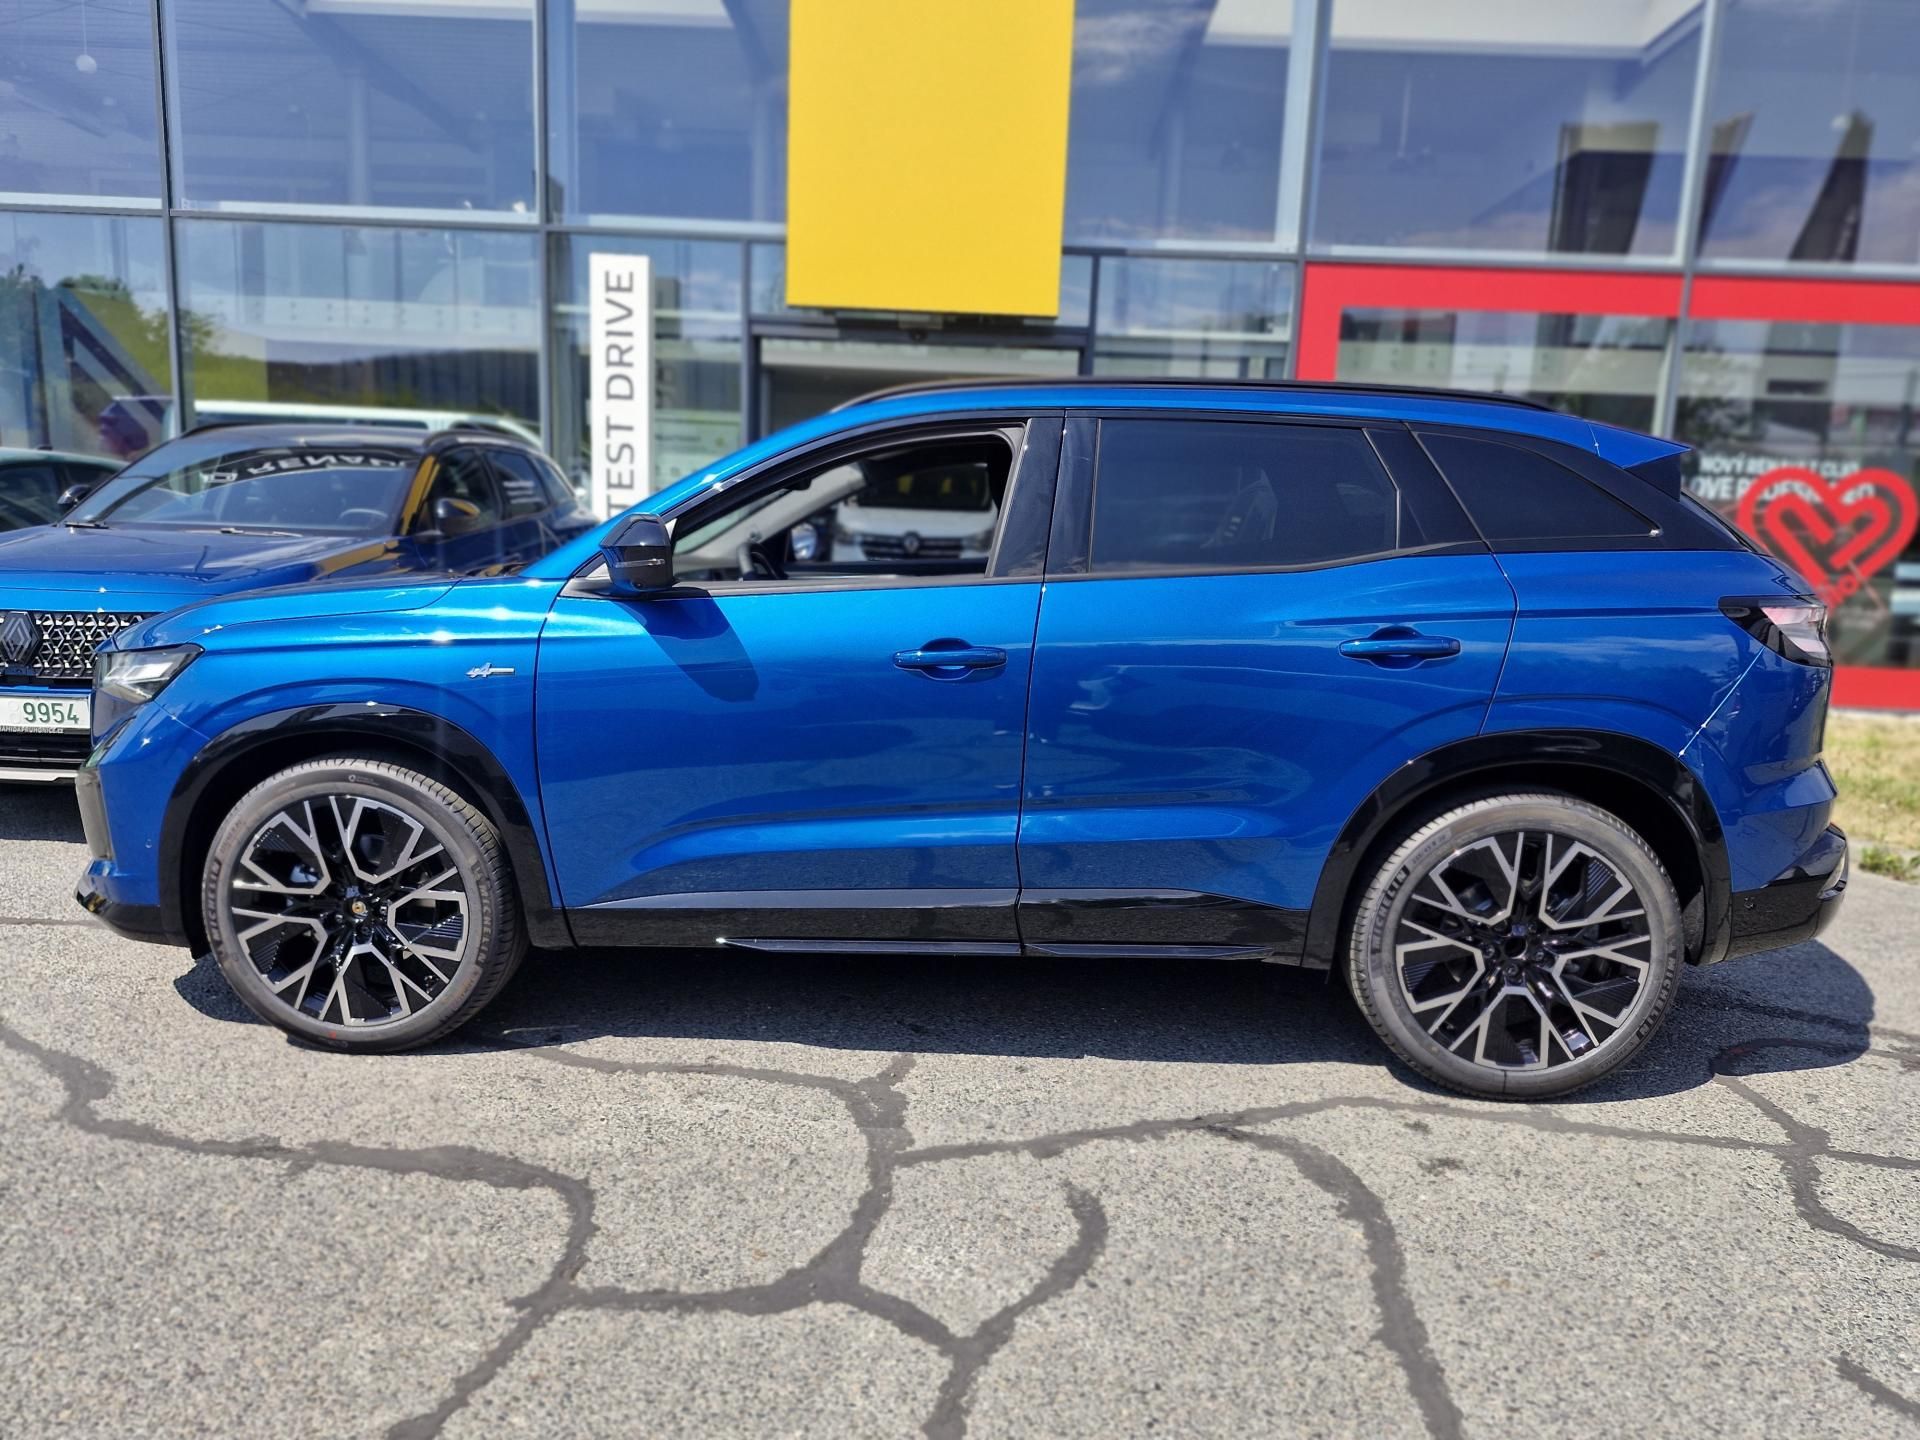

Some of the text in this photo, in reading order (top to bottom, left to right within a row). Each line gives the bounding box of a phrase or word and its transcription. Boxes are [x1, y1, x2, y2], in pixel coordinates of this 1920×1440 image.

[605, 271, 634, 523] TEST DRIVE
[23, 702, 80, 724] 9954
[206, 860, 222, 942] MICHELIN
[478, 883, 493, 963] MICHELIN
[1371, 870, 1408, 951] MICHELIN
[1640, 956, 1677, 1037] MICHELIN
